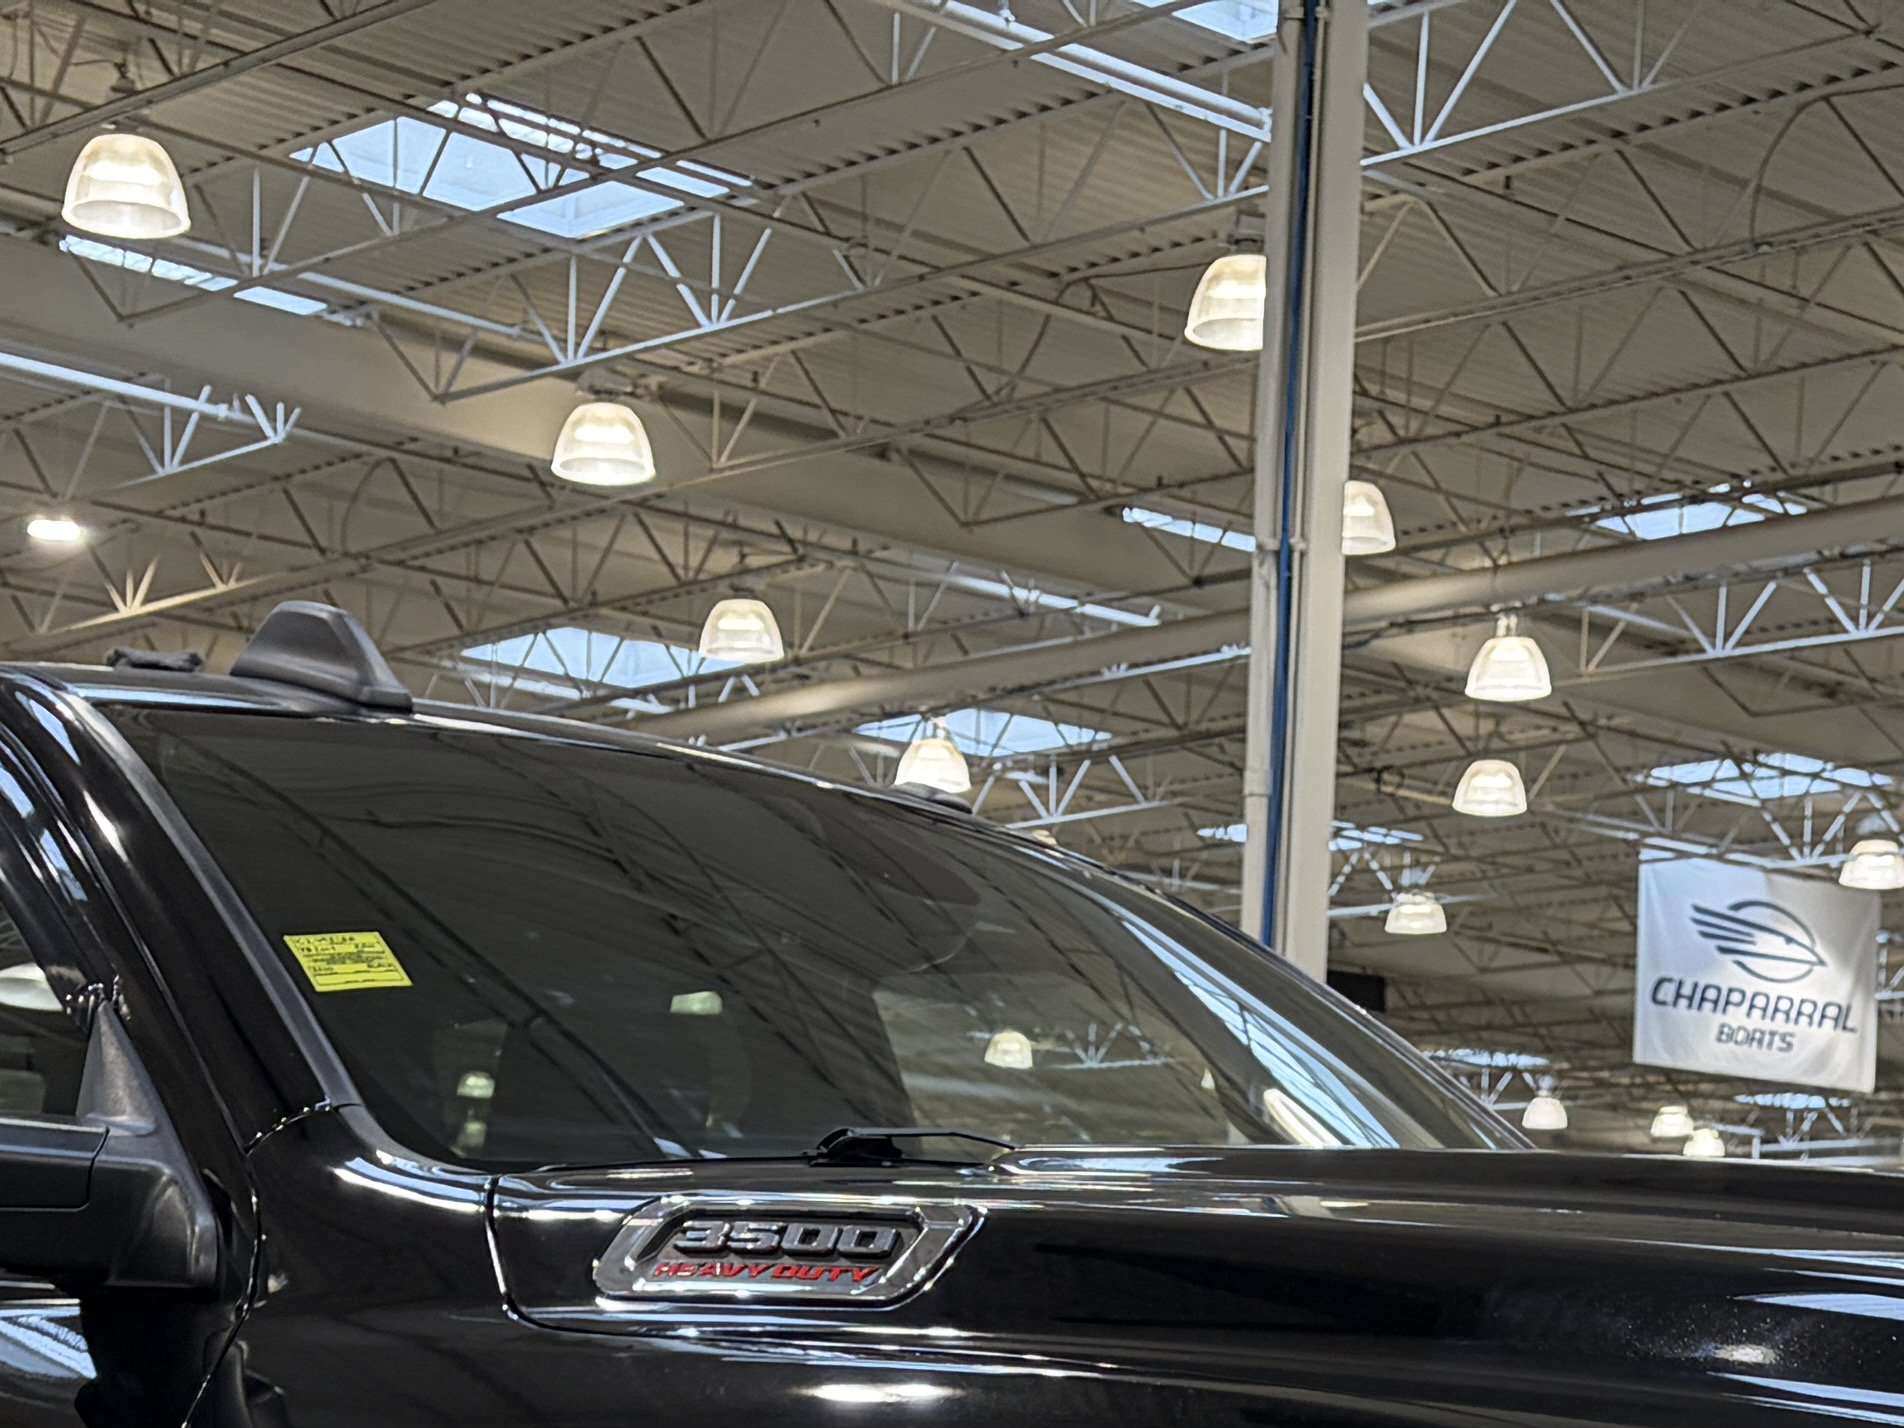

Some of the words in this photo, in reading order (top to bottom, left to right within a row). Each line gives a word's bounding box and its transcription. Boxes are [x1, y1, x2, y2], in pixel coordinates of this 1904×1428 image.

[1650, 976, 1859, 1034] CHAPARRAL
[1716, 1022, 1795, 1053] BOATS
[673, 1220, 901, 1257] 3500
[654, 1262, 770, 1279] HEAVY
[772, 1263, 881, 1282] DUTY
